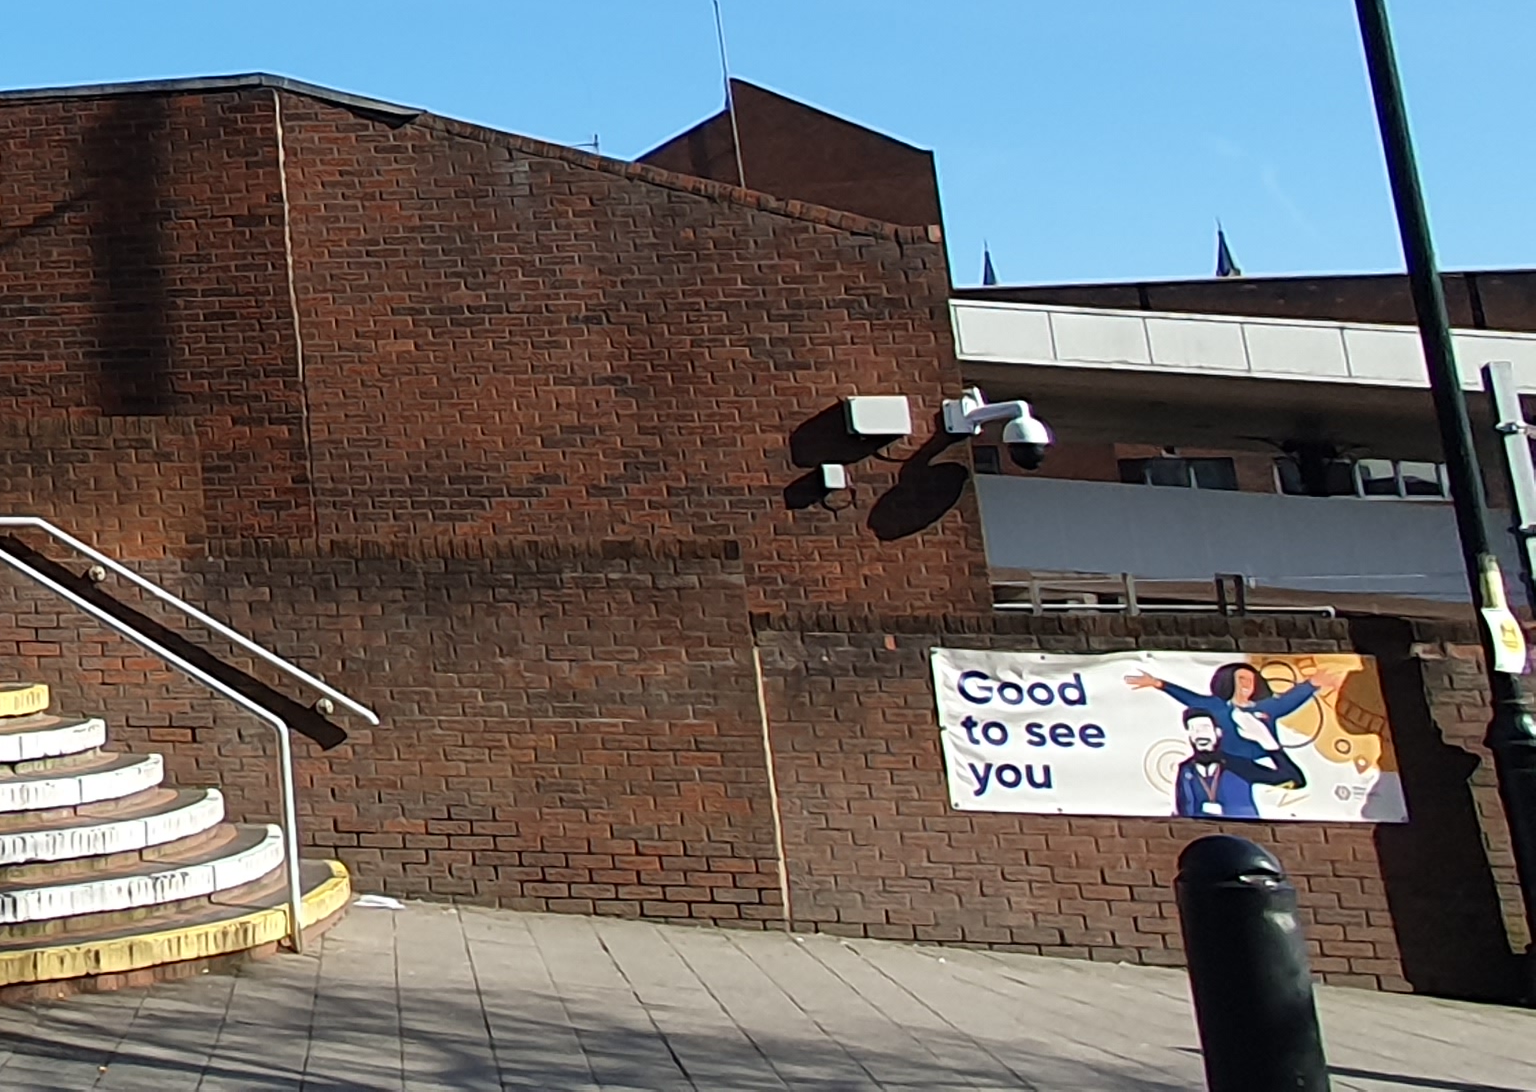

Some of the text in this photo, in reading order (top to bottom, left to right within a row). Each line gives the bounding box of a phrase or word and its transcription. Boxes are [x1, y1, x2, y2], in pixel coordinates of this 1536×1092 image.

[957, 670, 1087, 706] Good
[960, 715, 1106, 748] to see
[968, 763, 1053, 797] you
